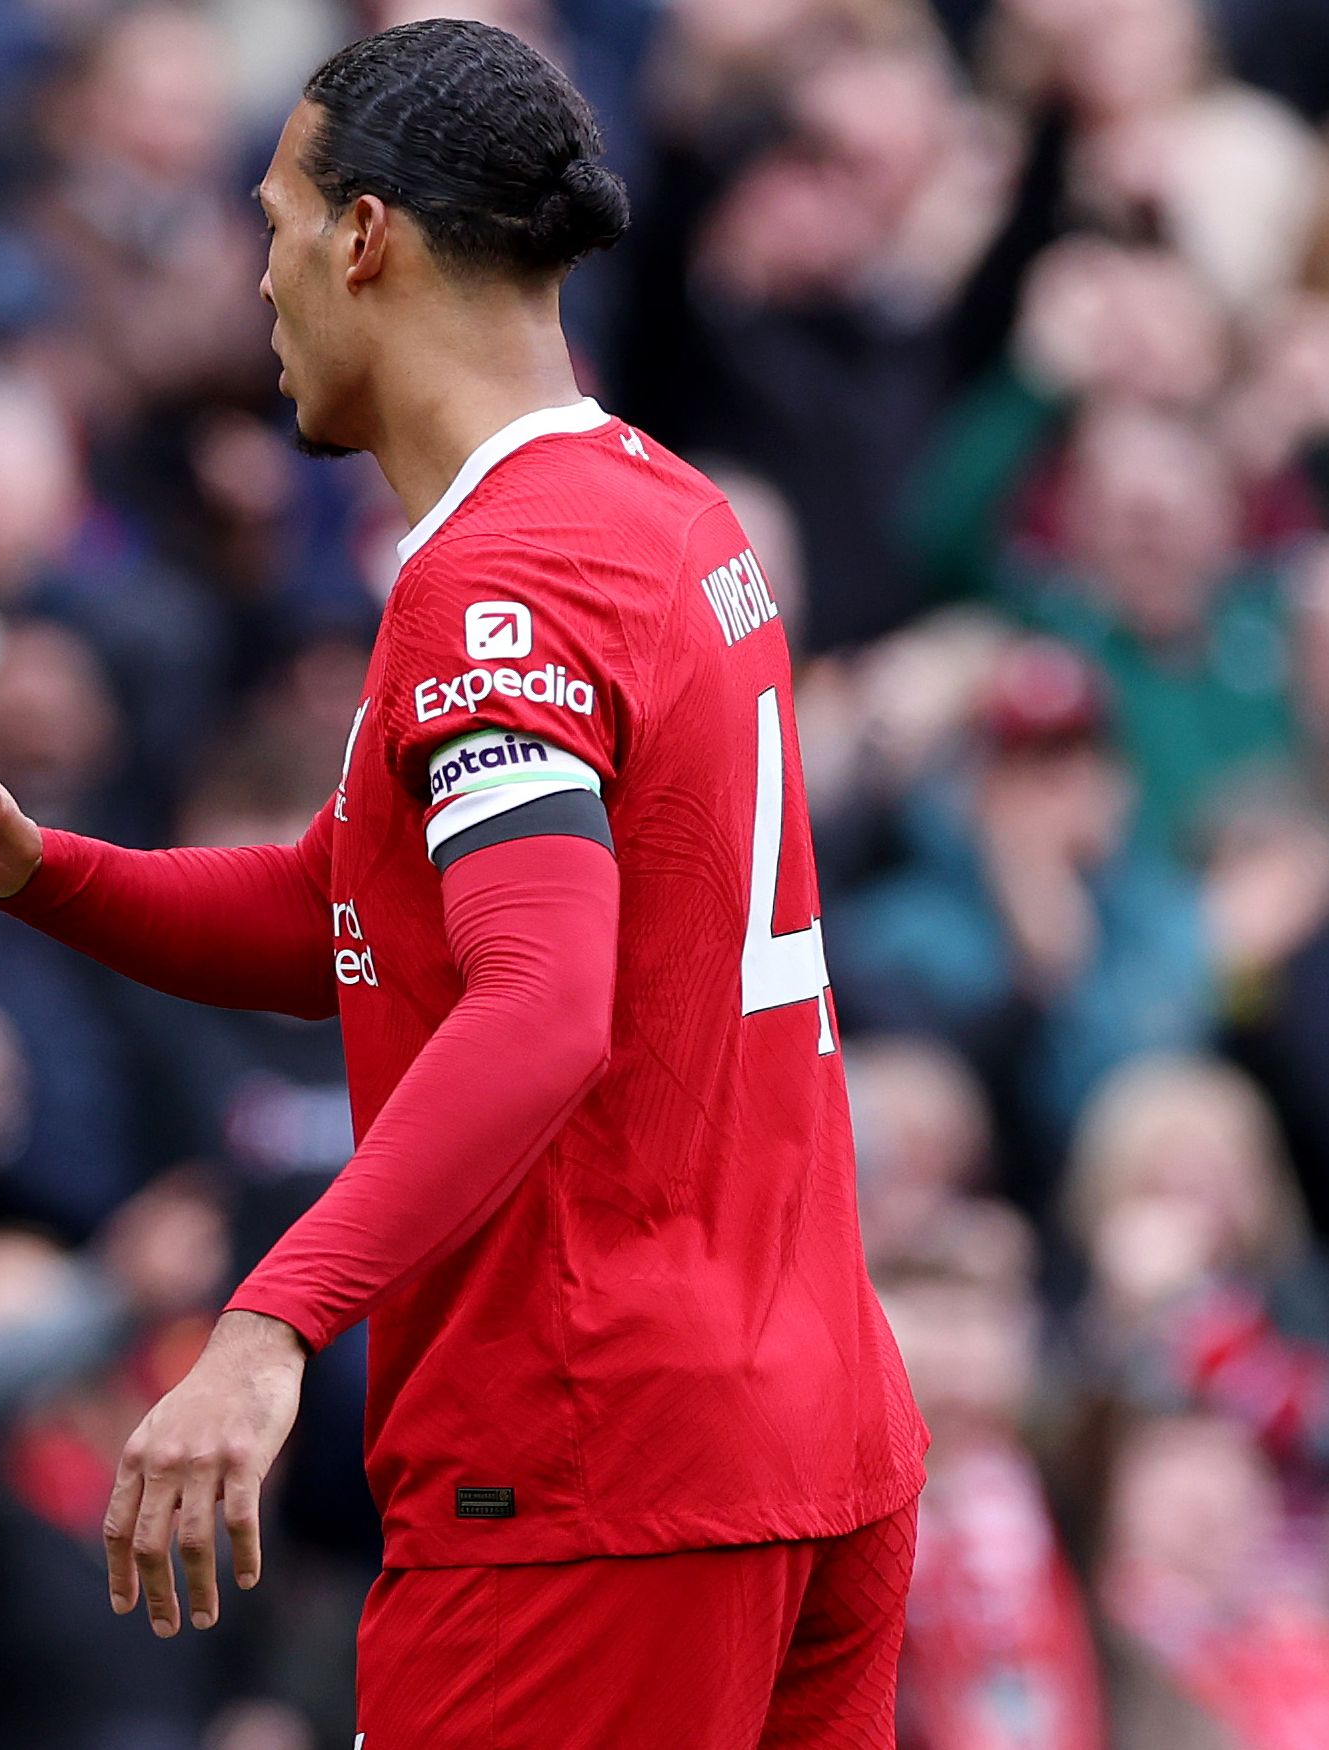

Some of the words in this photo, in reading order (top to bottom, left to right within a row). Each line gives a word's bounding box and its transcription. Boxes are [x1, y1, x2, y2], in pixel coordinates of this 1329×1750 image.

[700, 548, 778, 647] VIRGIL
[414, 663, 594, 723] Expedia
[431, 734, 549, 794] aptain
[741, 685, 837, 1055] 4
[332, 898, 364, 940] rd
[333, 944, 379, 987] ed
